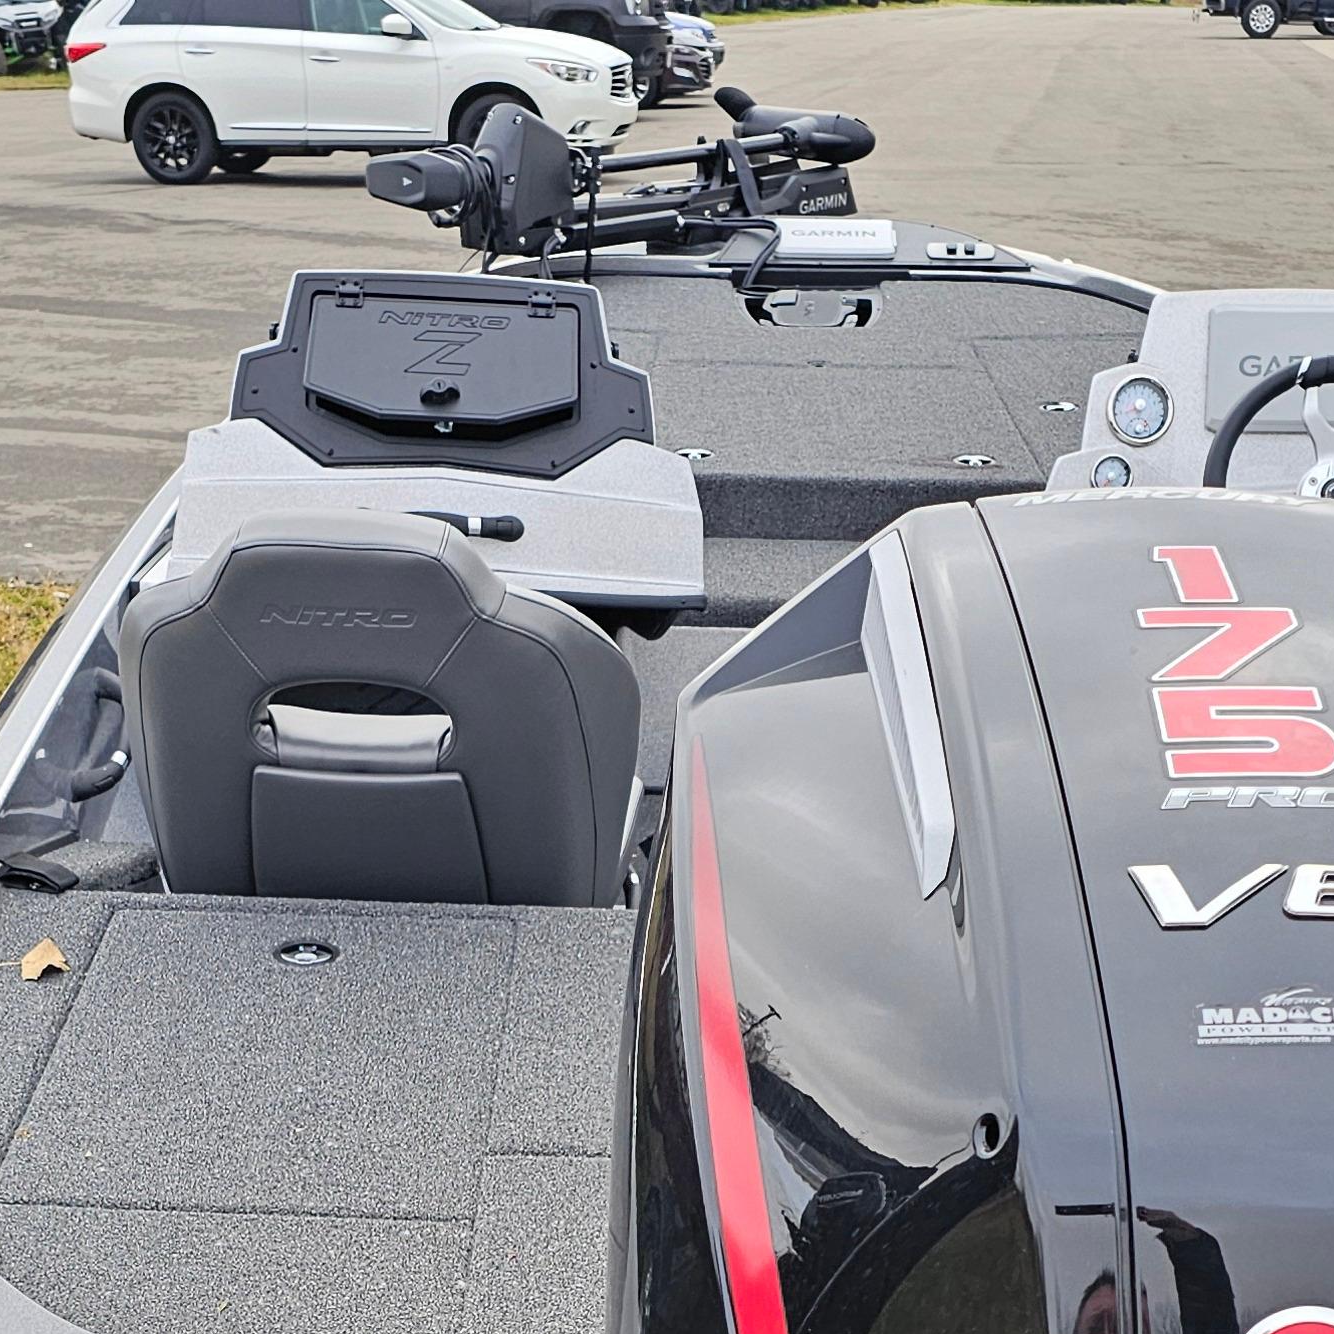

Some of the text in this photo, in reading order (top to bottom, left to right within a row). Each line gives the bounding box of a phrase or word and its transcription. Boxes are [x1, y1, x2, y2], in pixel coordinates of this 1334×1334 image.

[798, 191, 848, 215] GARMIN
[791, 228, 877, 238] GARMIN
[378, 310, 512, 330] NITRO
[403, 330, 483, 376] Z
[259, 603, 419, 629] NITRO
[1202, 1007, 1288, 1025] MAD
[1206, 1026, 1290, 1035] POWER
